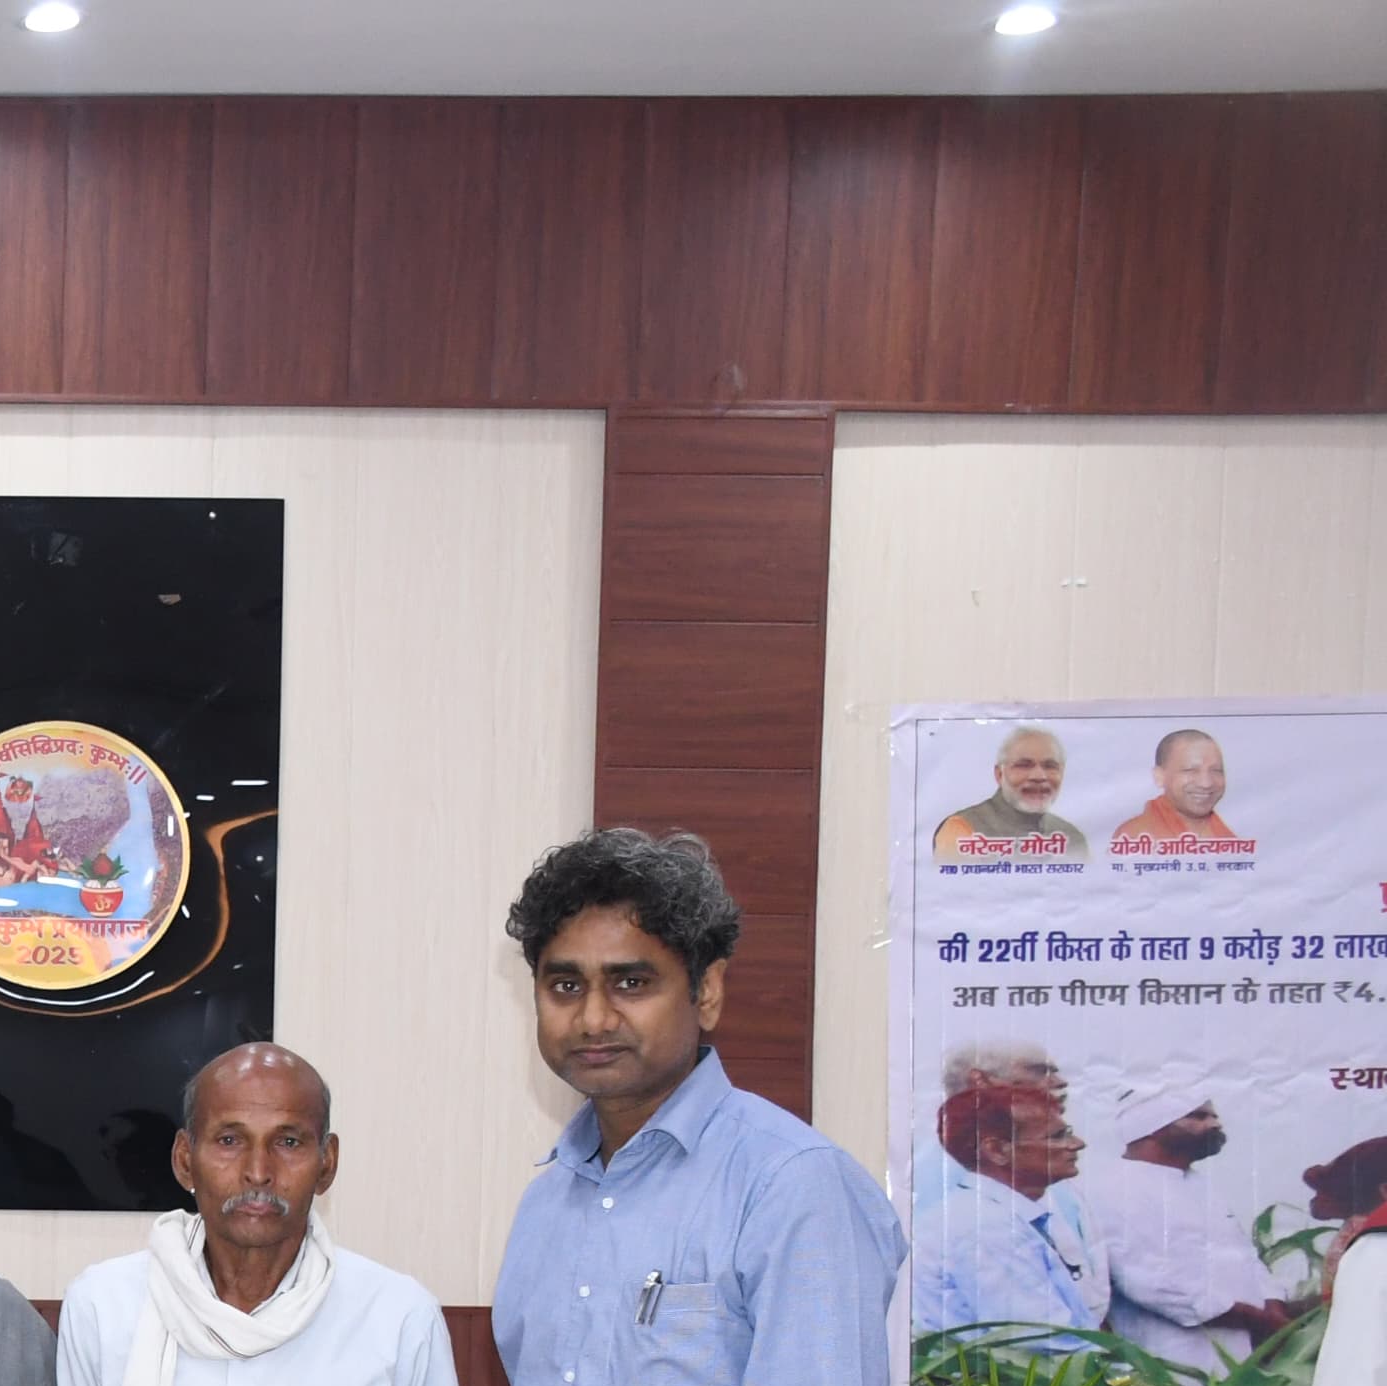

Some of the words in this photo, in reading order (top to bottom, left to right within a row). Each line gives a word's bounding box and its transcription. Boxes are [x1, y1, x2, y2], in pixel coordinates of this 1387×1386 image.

[958, 834, 1014, 856] नरेन्द्र
[1020, 833, 1066, 854] मोदी
[1110, 834, 1151, 855] योगी
[1157, 834, 1256, 855] आदित्यनाथ
[1046, 863, 1084, 874] सरकार
[1216, 861, 1255, 872] सरकार
[50, 917, 149, 940] प्रयागराज
[16, 946, 83, 966] 2025
[937, 932, 970, 963] की
[1046, 931, 1103, 962] किस्त
[1109, 930, 1134, 961] के
[1139, 937, 1191, 961] तहत
[1199, 936, 1214, 960] 9
[1222, 928, 1282, 966] करोड़
[1291, 935, 1324, 959] 32
[952, 986, 999, 1007] अब
[1006, 985, 1053, 1007] तक
[1059, 979, 1129, 1006] पीएम
[1137, 978, 1226, 1005] किसान
[1232, 977, 1261, 1004] के
[1267, 982, 1325, 1004] तहत
[1329, 1067, 1387, 1090] स्था
